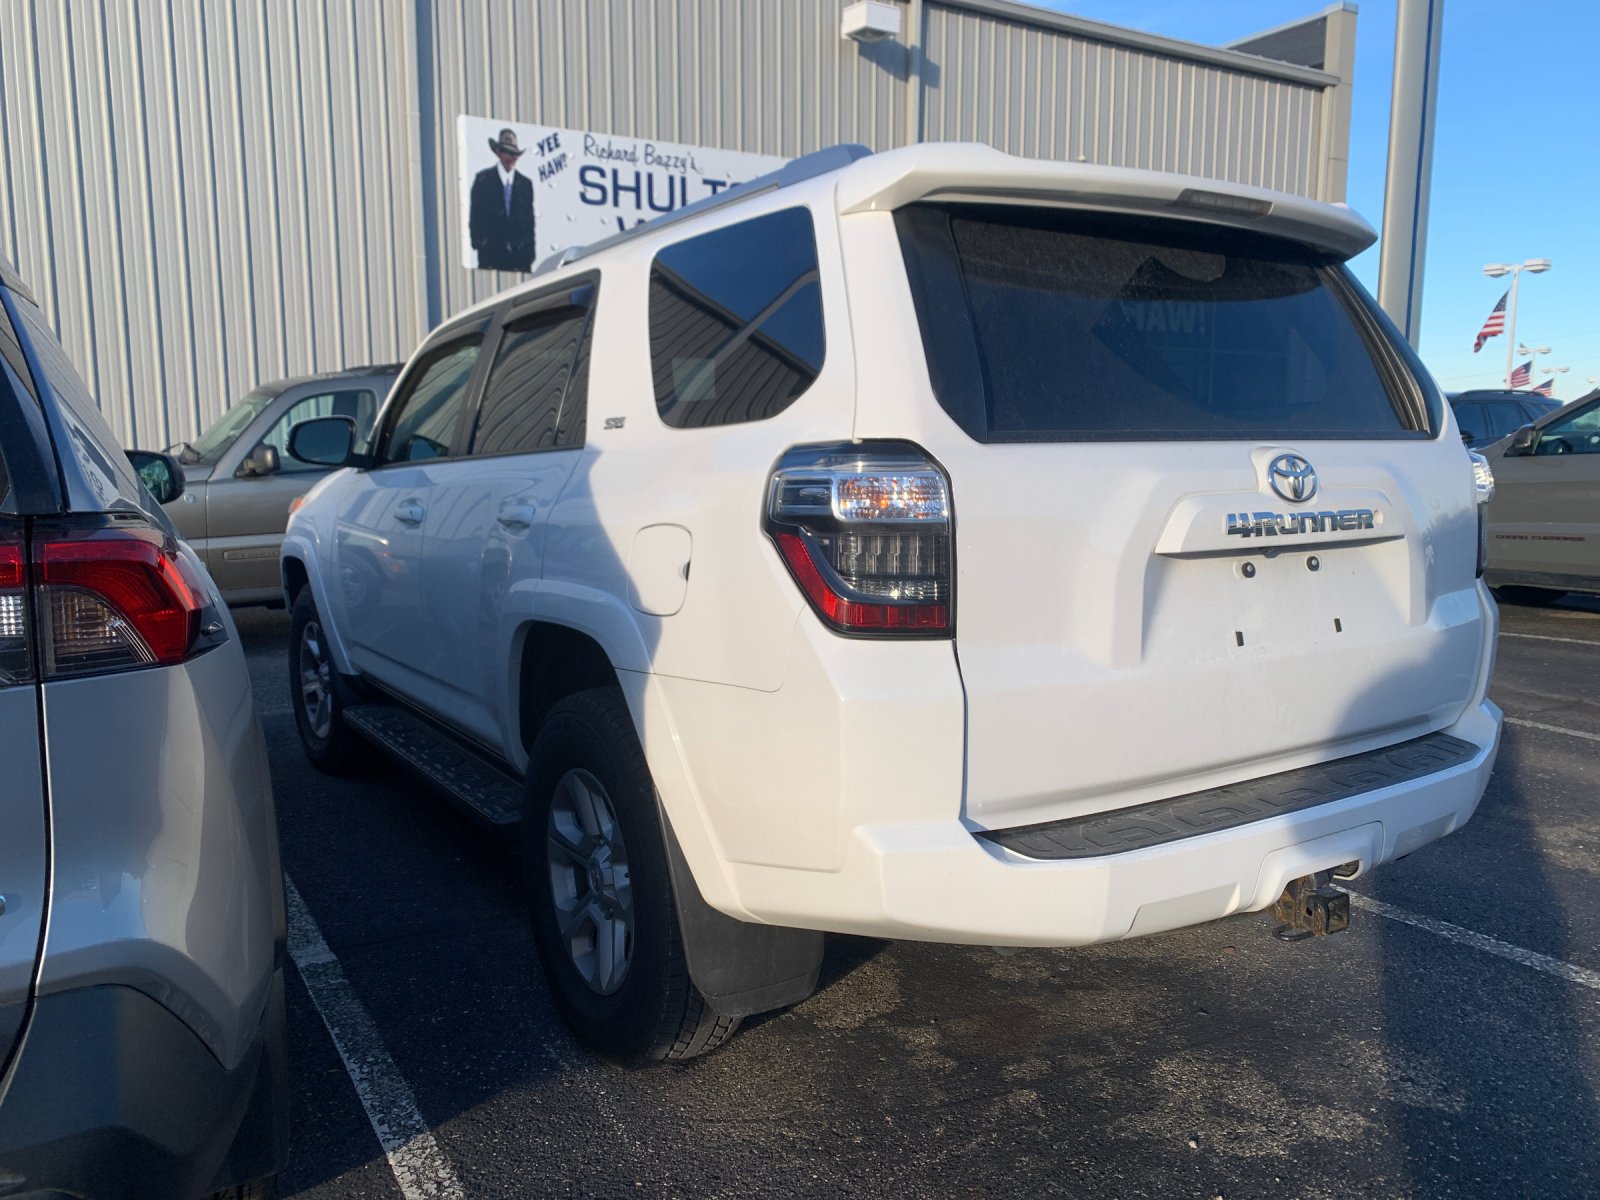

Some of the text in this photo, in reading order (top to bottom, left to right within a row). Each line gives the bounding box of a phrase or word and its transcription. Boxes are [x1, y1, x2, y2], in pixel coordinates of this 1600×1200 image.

[536, 132, 561, 157] YEE
[583, 133, 640, 167] Richard
[578, 163, 746, 213] SHULT
[1225, 508, 1376, 539] 4RUNNER
